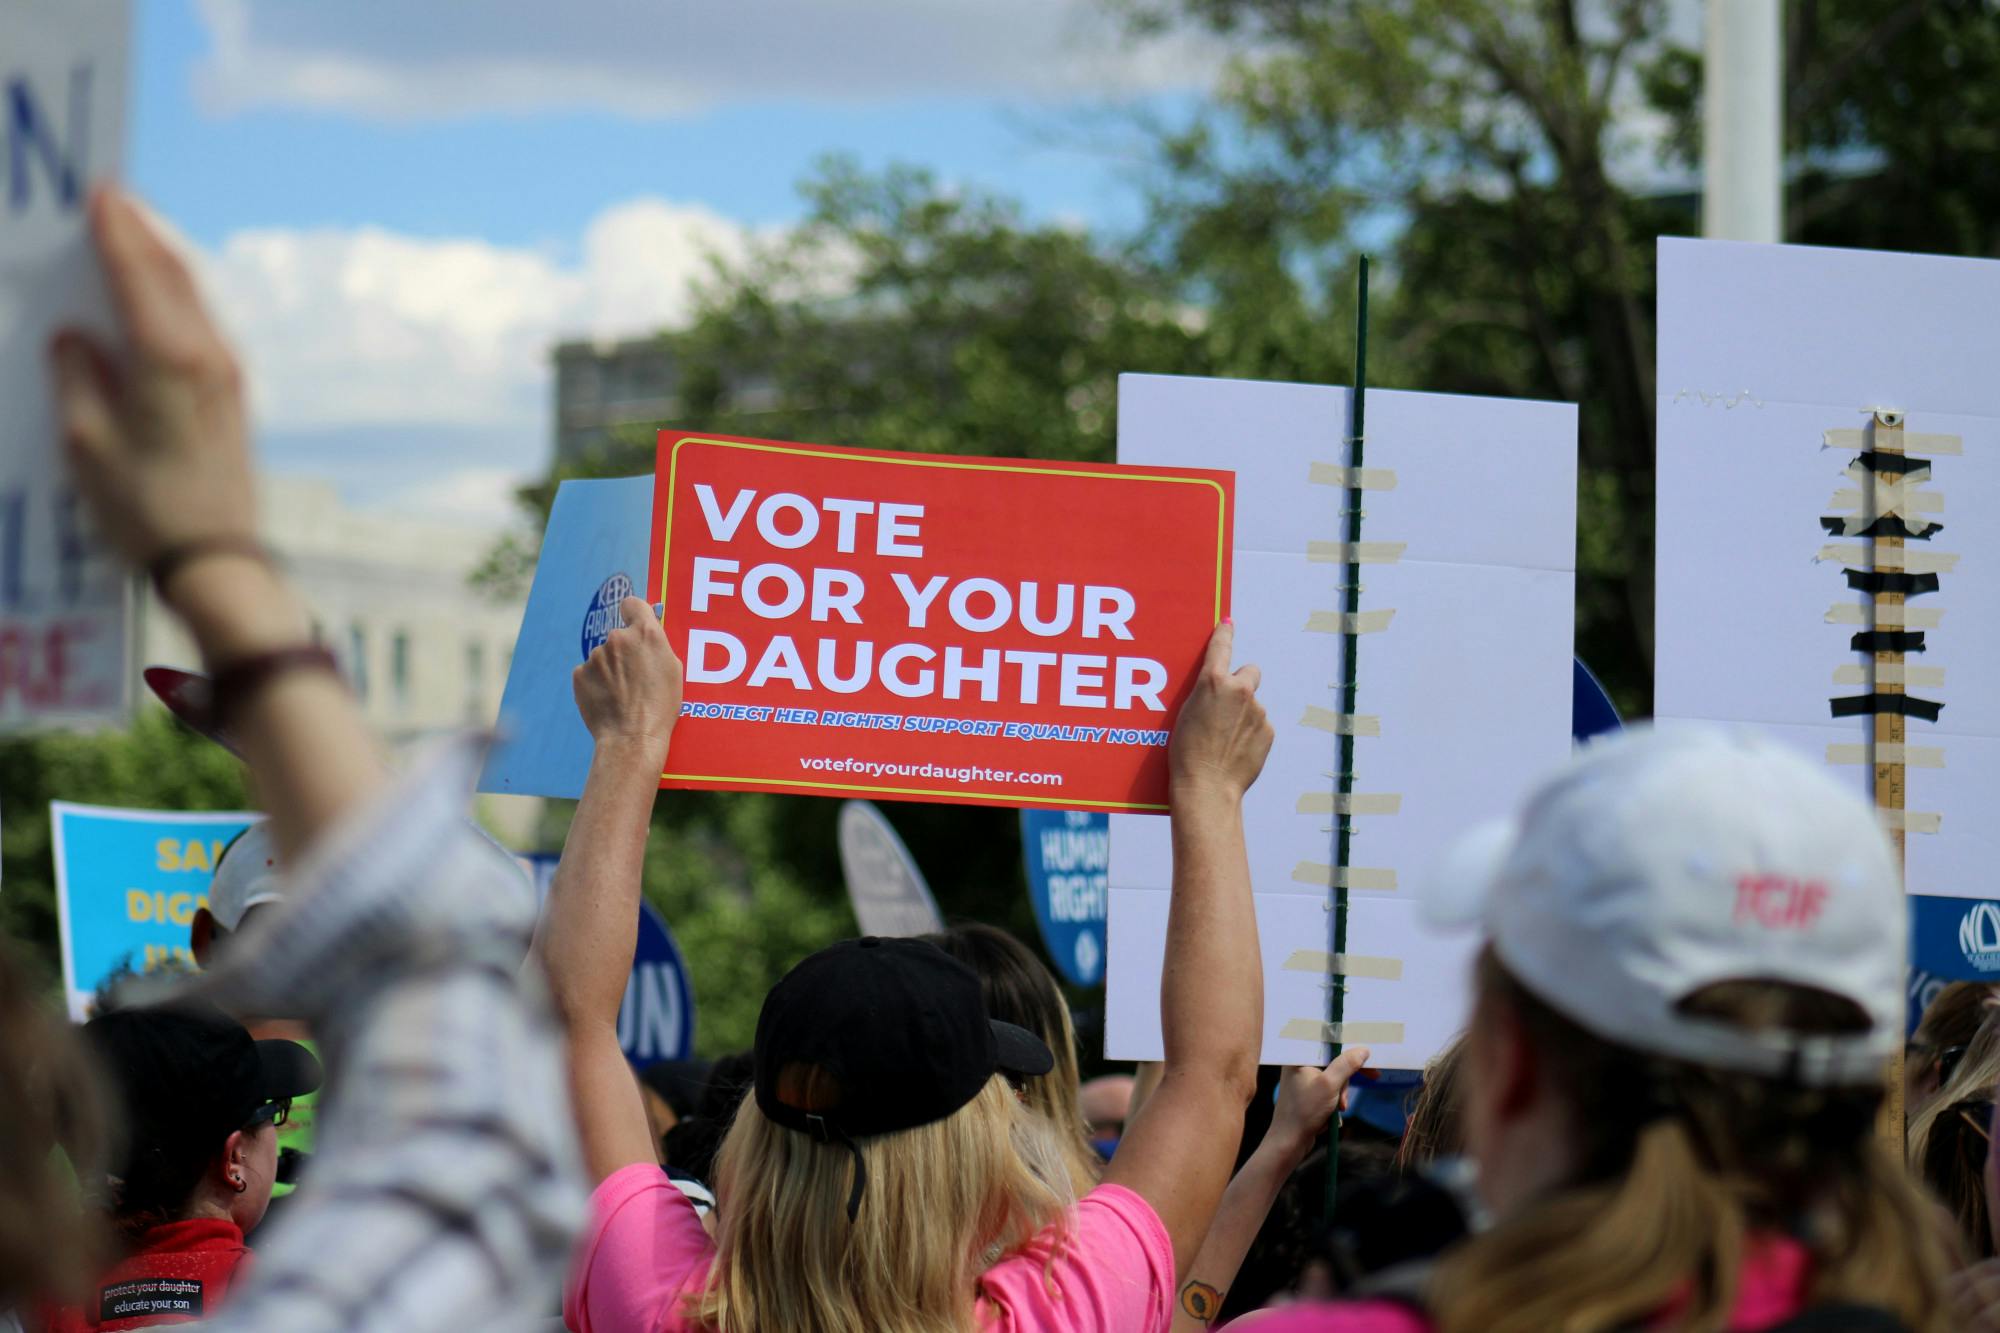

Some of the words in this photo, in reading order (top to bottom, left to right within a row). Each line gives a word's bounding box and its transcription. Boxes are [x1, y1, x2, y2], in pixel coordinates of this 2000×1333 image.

[693, 484, 925, 558] VOTE
[690, 556, 865, 624] FOR
[890, 572, 1136, 641] YOUR
[685, 628, 1168, 712] DAUGHTER
[680, 702, 773, 721] PROTECT
[774, 707, 818, 725] HER
[820, 711, 902, 730] RIGHTS!
[903, 716, 1003, 736] SUPPORT
[1003, 722, 1108, 742] EQUALITY
[1107, 728, 1170, 746] NOW!
[800, 757, 1063, 786] voteforyourdaughter.com
[104, 1283, 136, 1300] protect
[137, 1283, 158, 1296] your
[159, 1281, 200, 1295] daughter
[114, 1300, 149, 1313] educate
[151, 1299, 171, 1311] your
[173, 1300, 190, 1309] son
